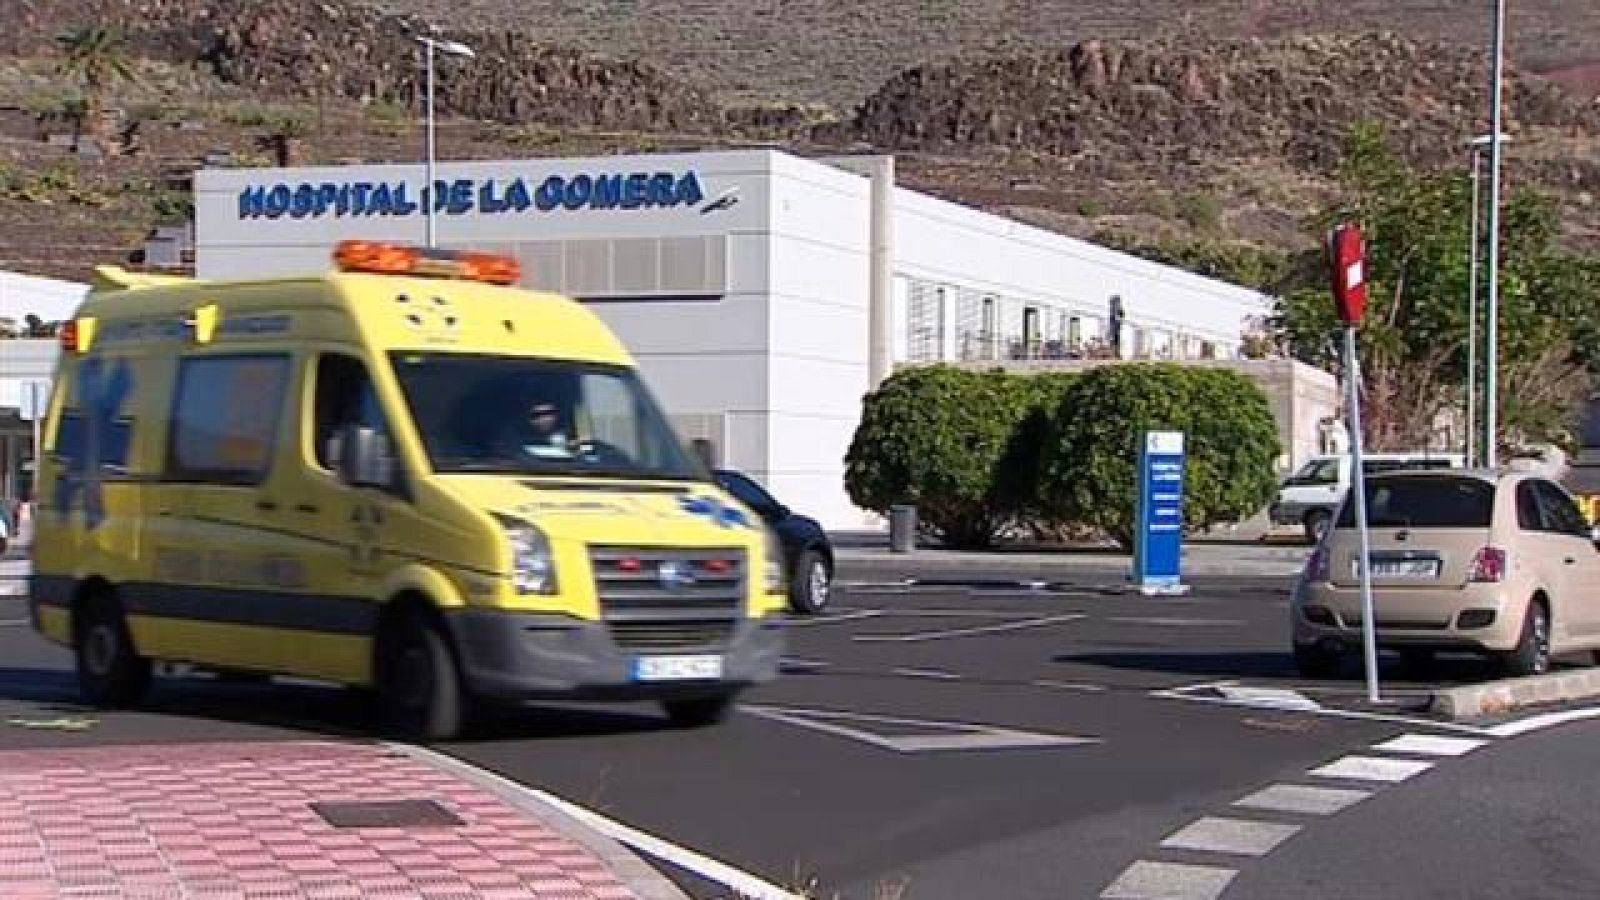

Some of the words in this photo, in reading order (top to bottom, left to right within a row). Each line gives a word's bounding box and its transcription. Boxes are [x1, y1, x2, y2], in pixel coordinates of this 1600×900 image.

[239, 181, 418, 220] HOSPITAL
[420, 179, 474, 215] DE
[479, 177, 531, 213] LA
[535, 171, 703, 211] GOMERA
